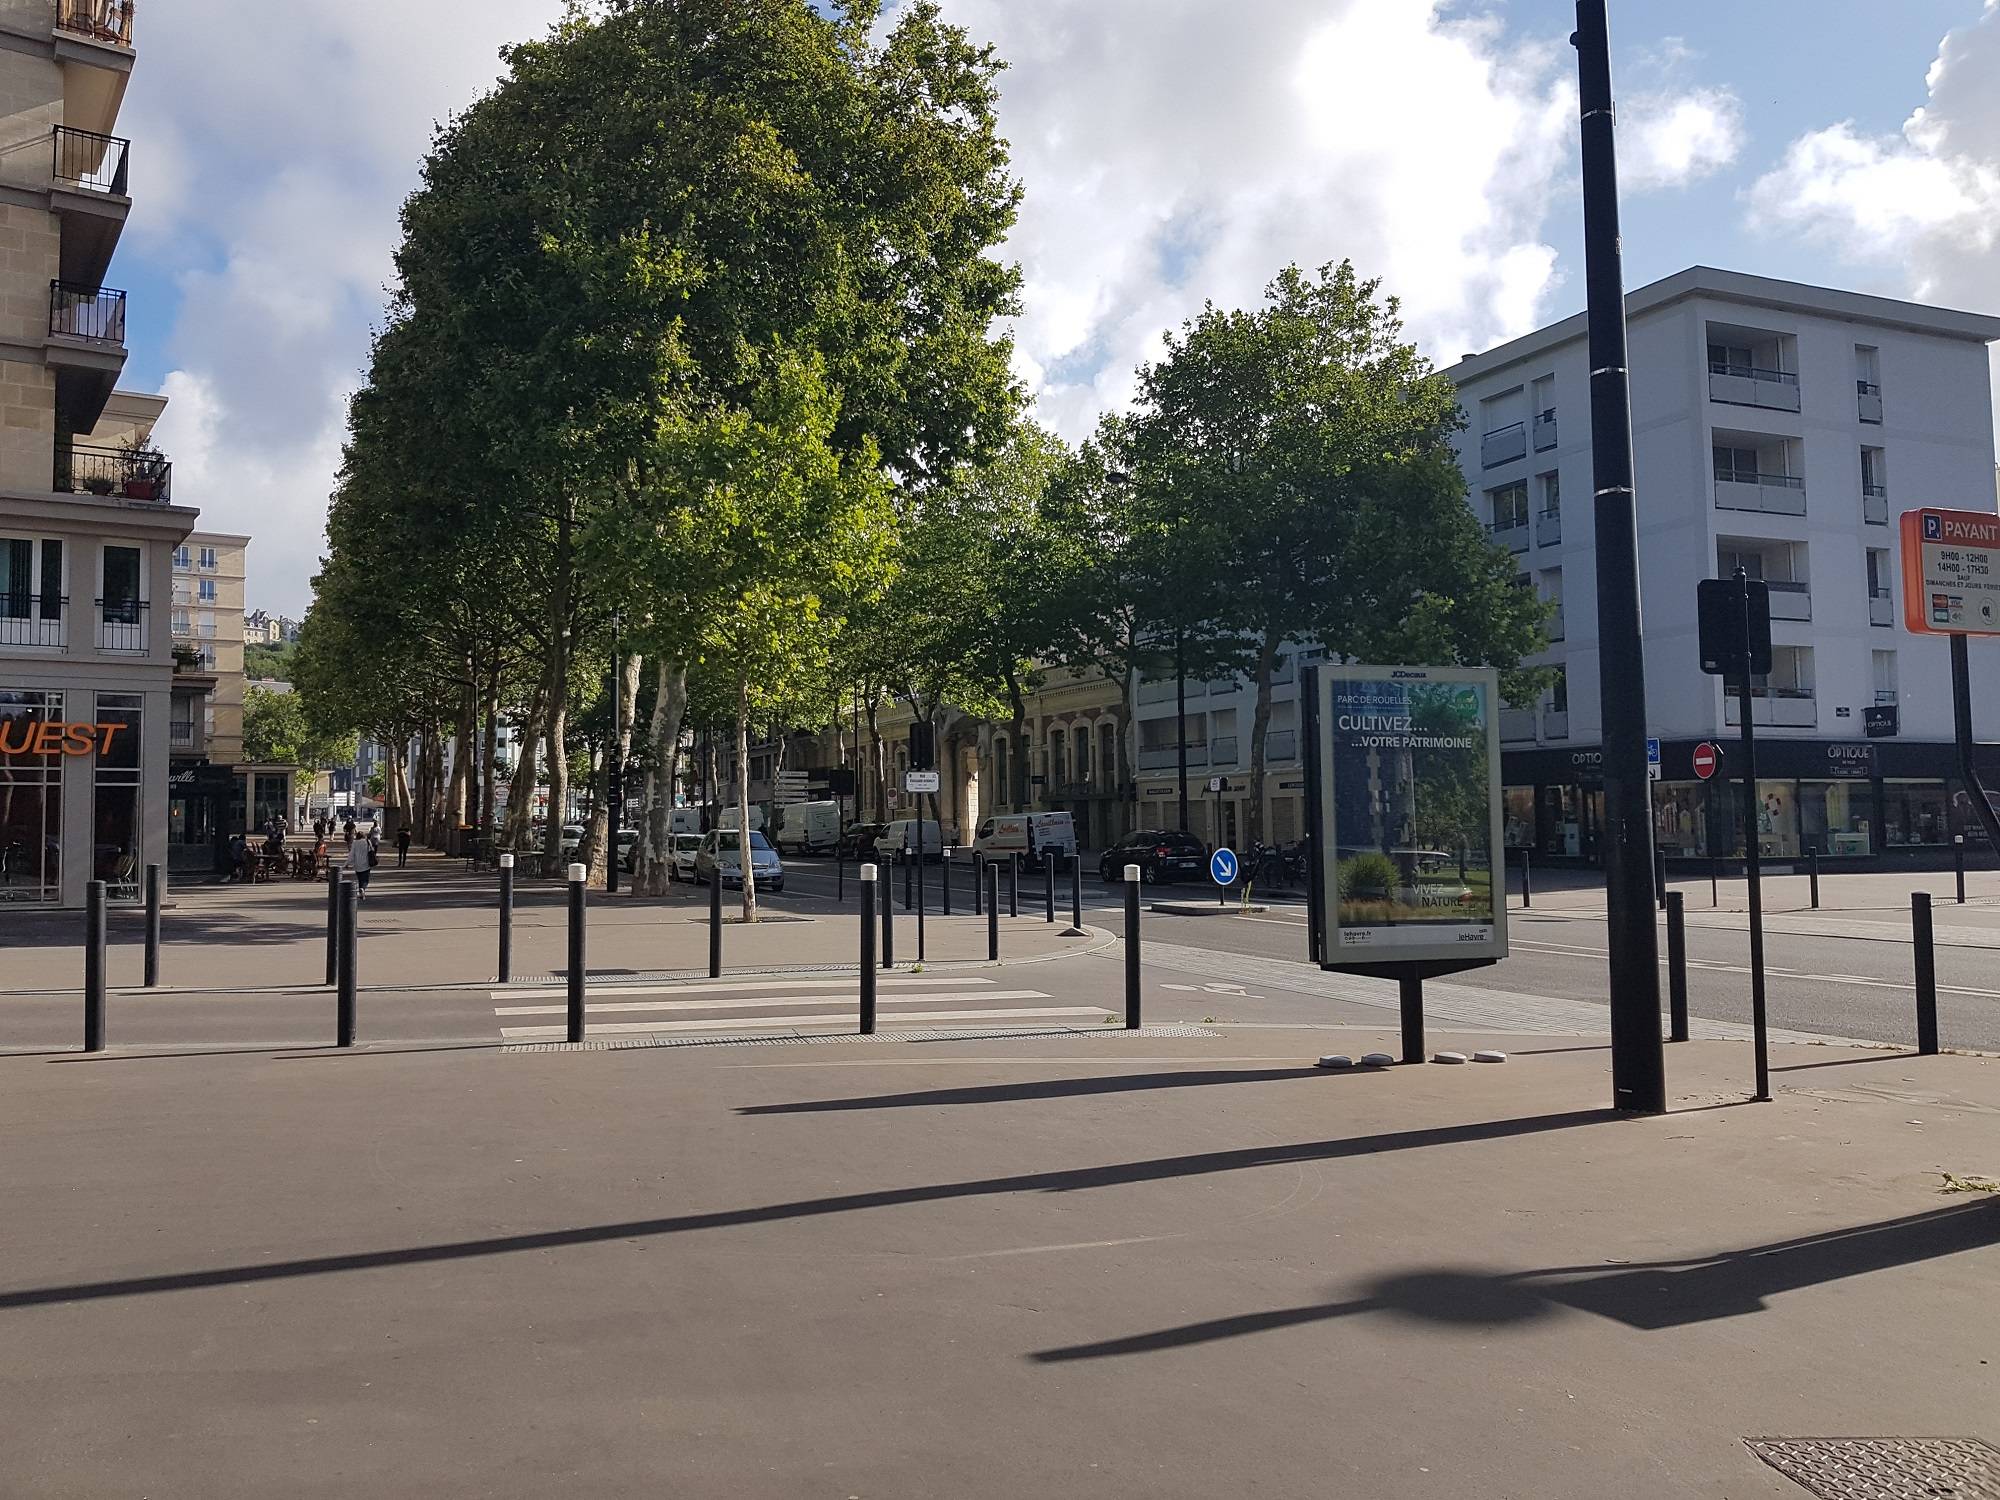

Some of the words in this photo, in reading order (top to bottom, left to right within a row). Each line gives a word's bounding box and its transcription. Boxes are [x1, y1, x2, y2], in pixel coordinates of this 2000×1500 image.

[1928, 519, 1936, 535] P
[1945, 521, 1998, 540] PAYANT
[1941, 551, 1960, 561] 9H00
[1966, 553, 1988, 564] 12H00
[1937, 562, 1960, 573] 14H00
[1967, 564, 1989, 575] 17H30
[1391, 671, 1427, 679] JCDecaux
[1337, 695, 1360, 704] PARC
[1360, 696, 1371, 704] DE
[1338, 715, 1428, 732] CULTIVEZ...
[0, 720, 128, 756] UEST
[1351, 736, 1400, 748] ...VOTRE
[1402, 737, 1472, 749] PATRIMOINE
[1827, 746, 1869, 759] OPTIQUE
[1413, 883, 1444, 895] VIVEZ
[1421, 896, 1464, 908] NATURE
